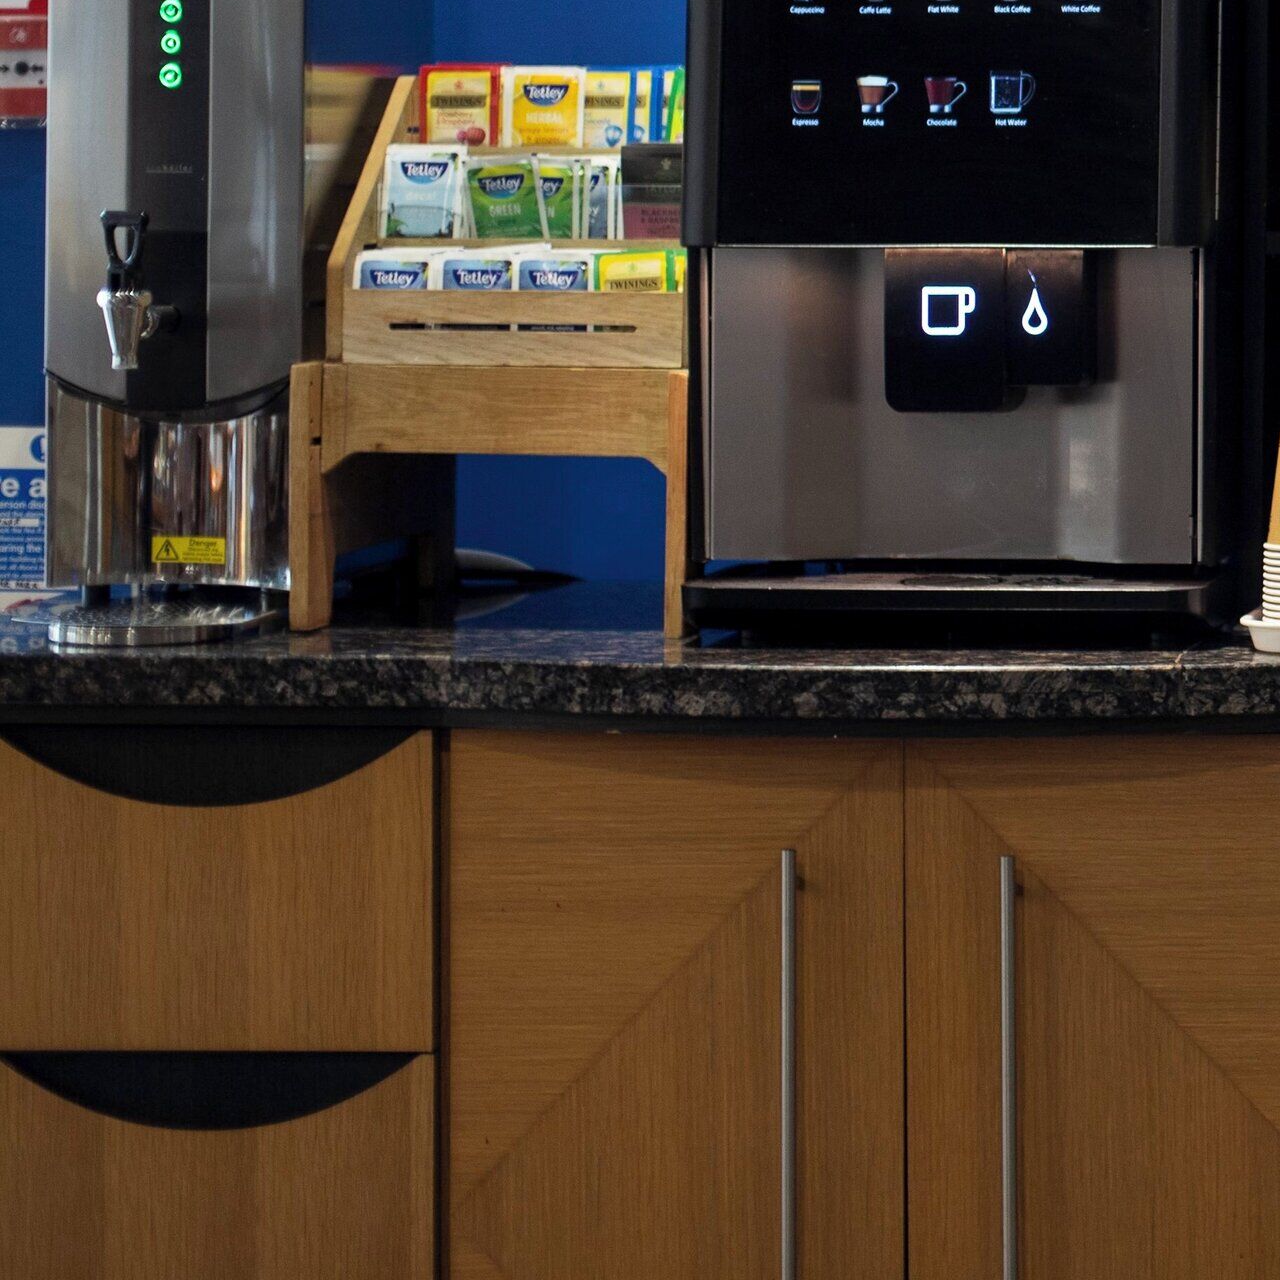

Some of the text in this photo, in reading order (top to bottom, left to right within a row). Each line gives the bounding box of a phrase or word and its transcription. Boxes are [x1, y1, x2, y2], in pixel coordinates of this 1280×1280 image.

[790, 6, 825, 14] Cappuccino
[927, 5, 960, 14] Flat White
[1061, 5, 1101, 13] White Coffee
[527, 86, 565, 100] Tetley
[792, 118, 819, 127] Espresso
[863, 118, 884, 126] Mocha
[926, 118, 957, 126] Chocolate
[995, 118, 1027, 126] Hot Water
[405, 163, 443, 179] Tetley
[483, 175, 520, 192] Tetley
[489, 204, 521, 217] GREEN
[374, 271, 414, 287] Tetley
[459, 270, 498, 287] Tetley
[533, 270, 573, 287] Tetley
[609, 279, 658, 290] TWININGS
